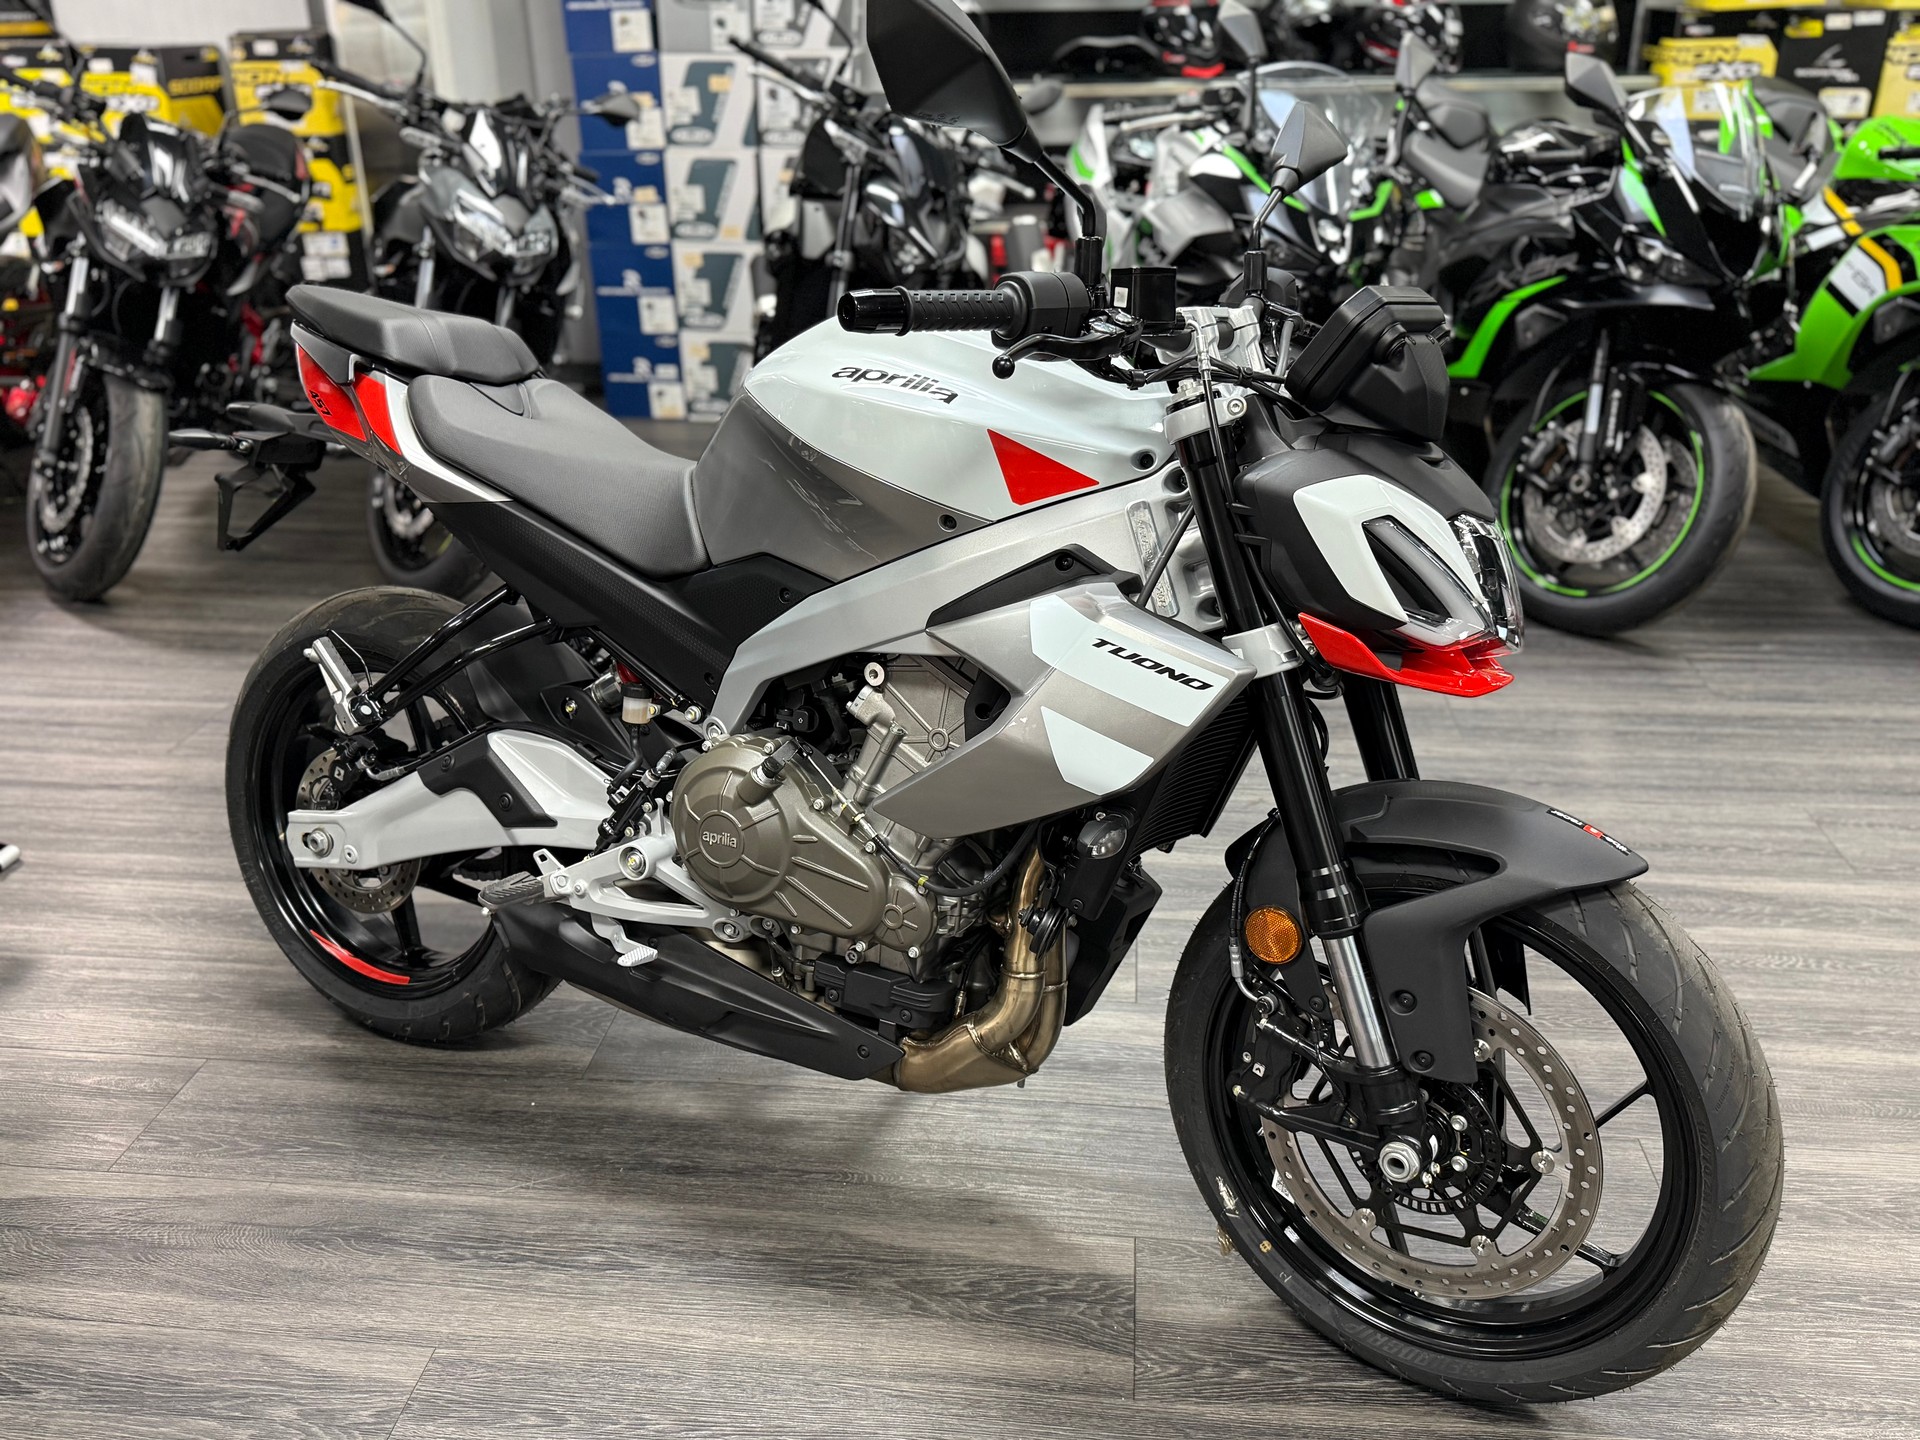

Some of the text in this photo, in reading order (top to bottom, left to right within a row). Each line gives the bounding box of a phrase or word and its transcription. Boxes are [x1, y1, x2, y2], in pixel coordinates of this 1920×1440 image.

[831, 366, 959, 404] aprilia
[309, 390, 332, 416] 457
[1091, 637, 1214, 690] TUONO
[702, 831, 737, 848] aprilia
